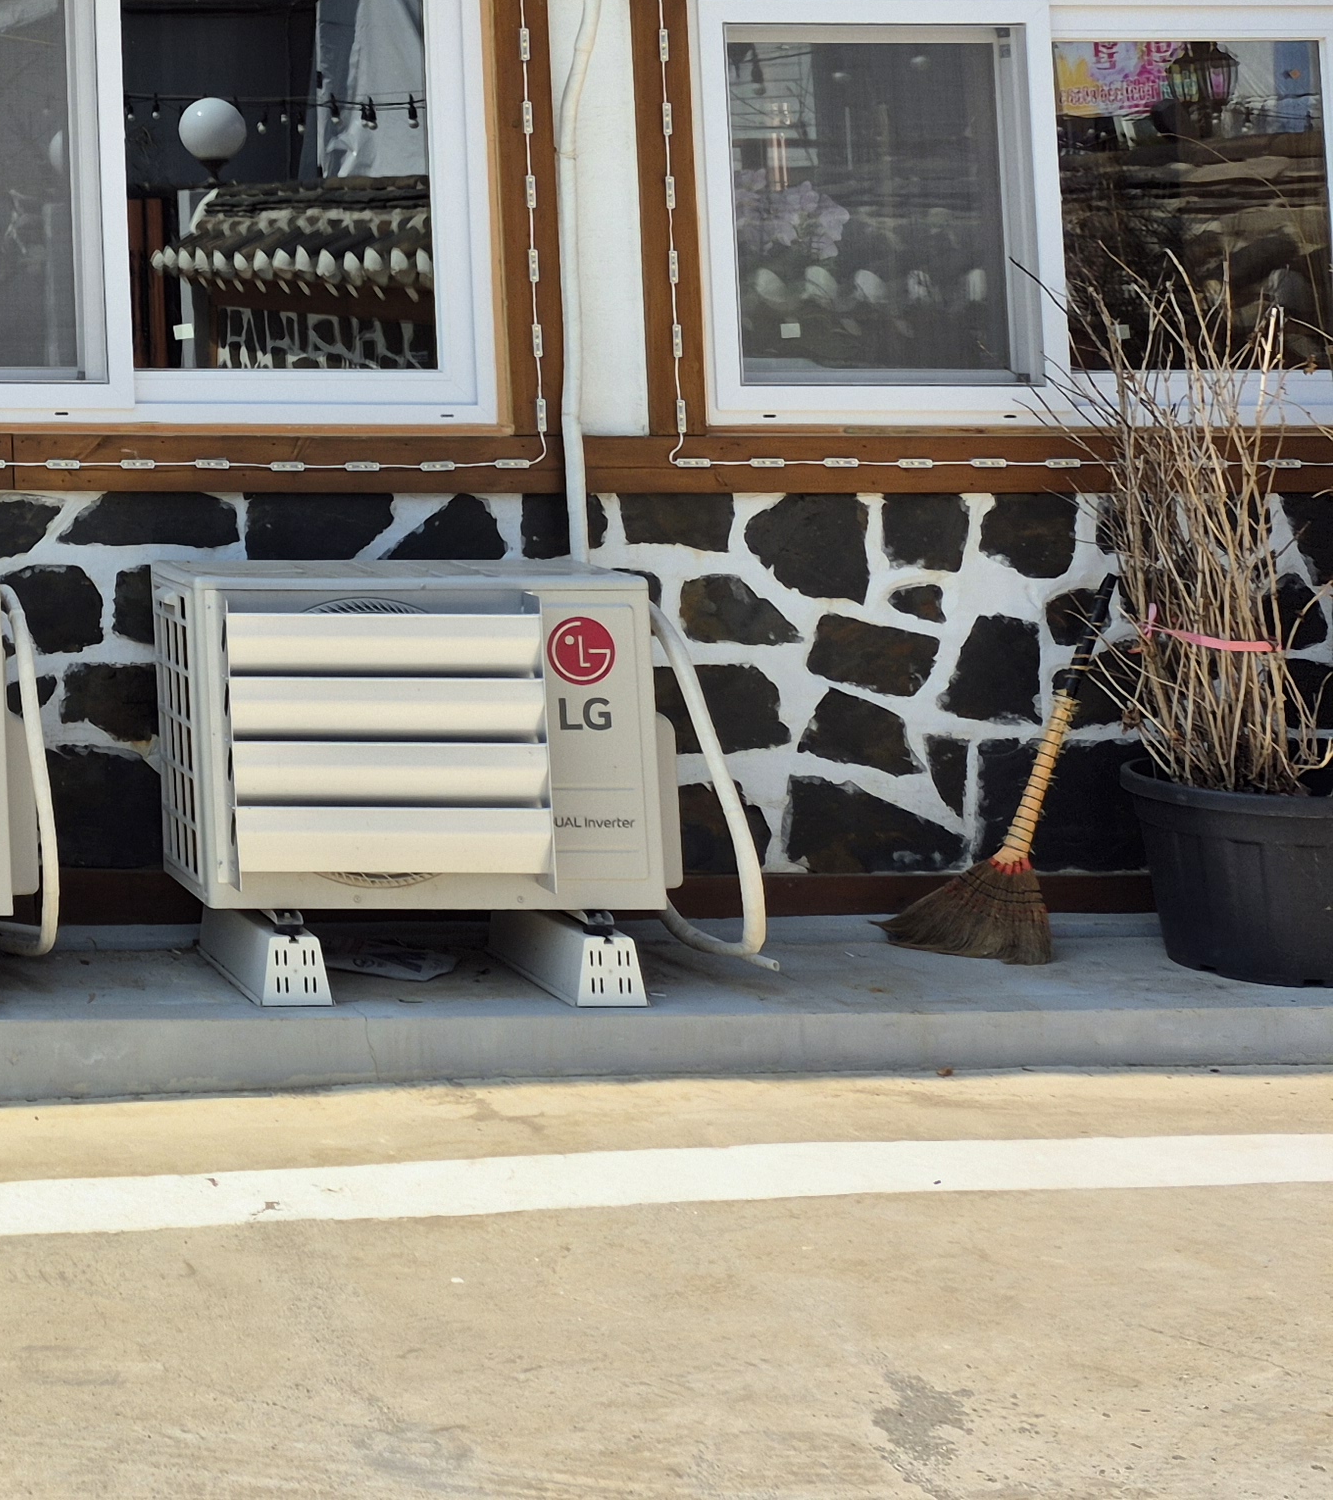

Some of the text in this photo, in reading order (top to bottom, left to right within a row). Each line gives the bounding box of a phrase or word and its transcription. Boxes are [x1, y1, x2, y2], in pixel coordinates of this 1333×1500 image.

[558, 697, 613, 731] LG
[554, 816, 635, 829] UAL Inverter
